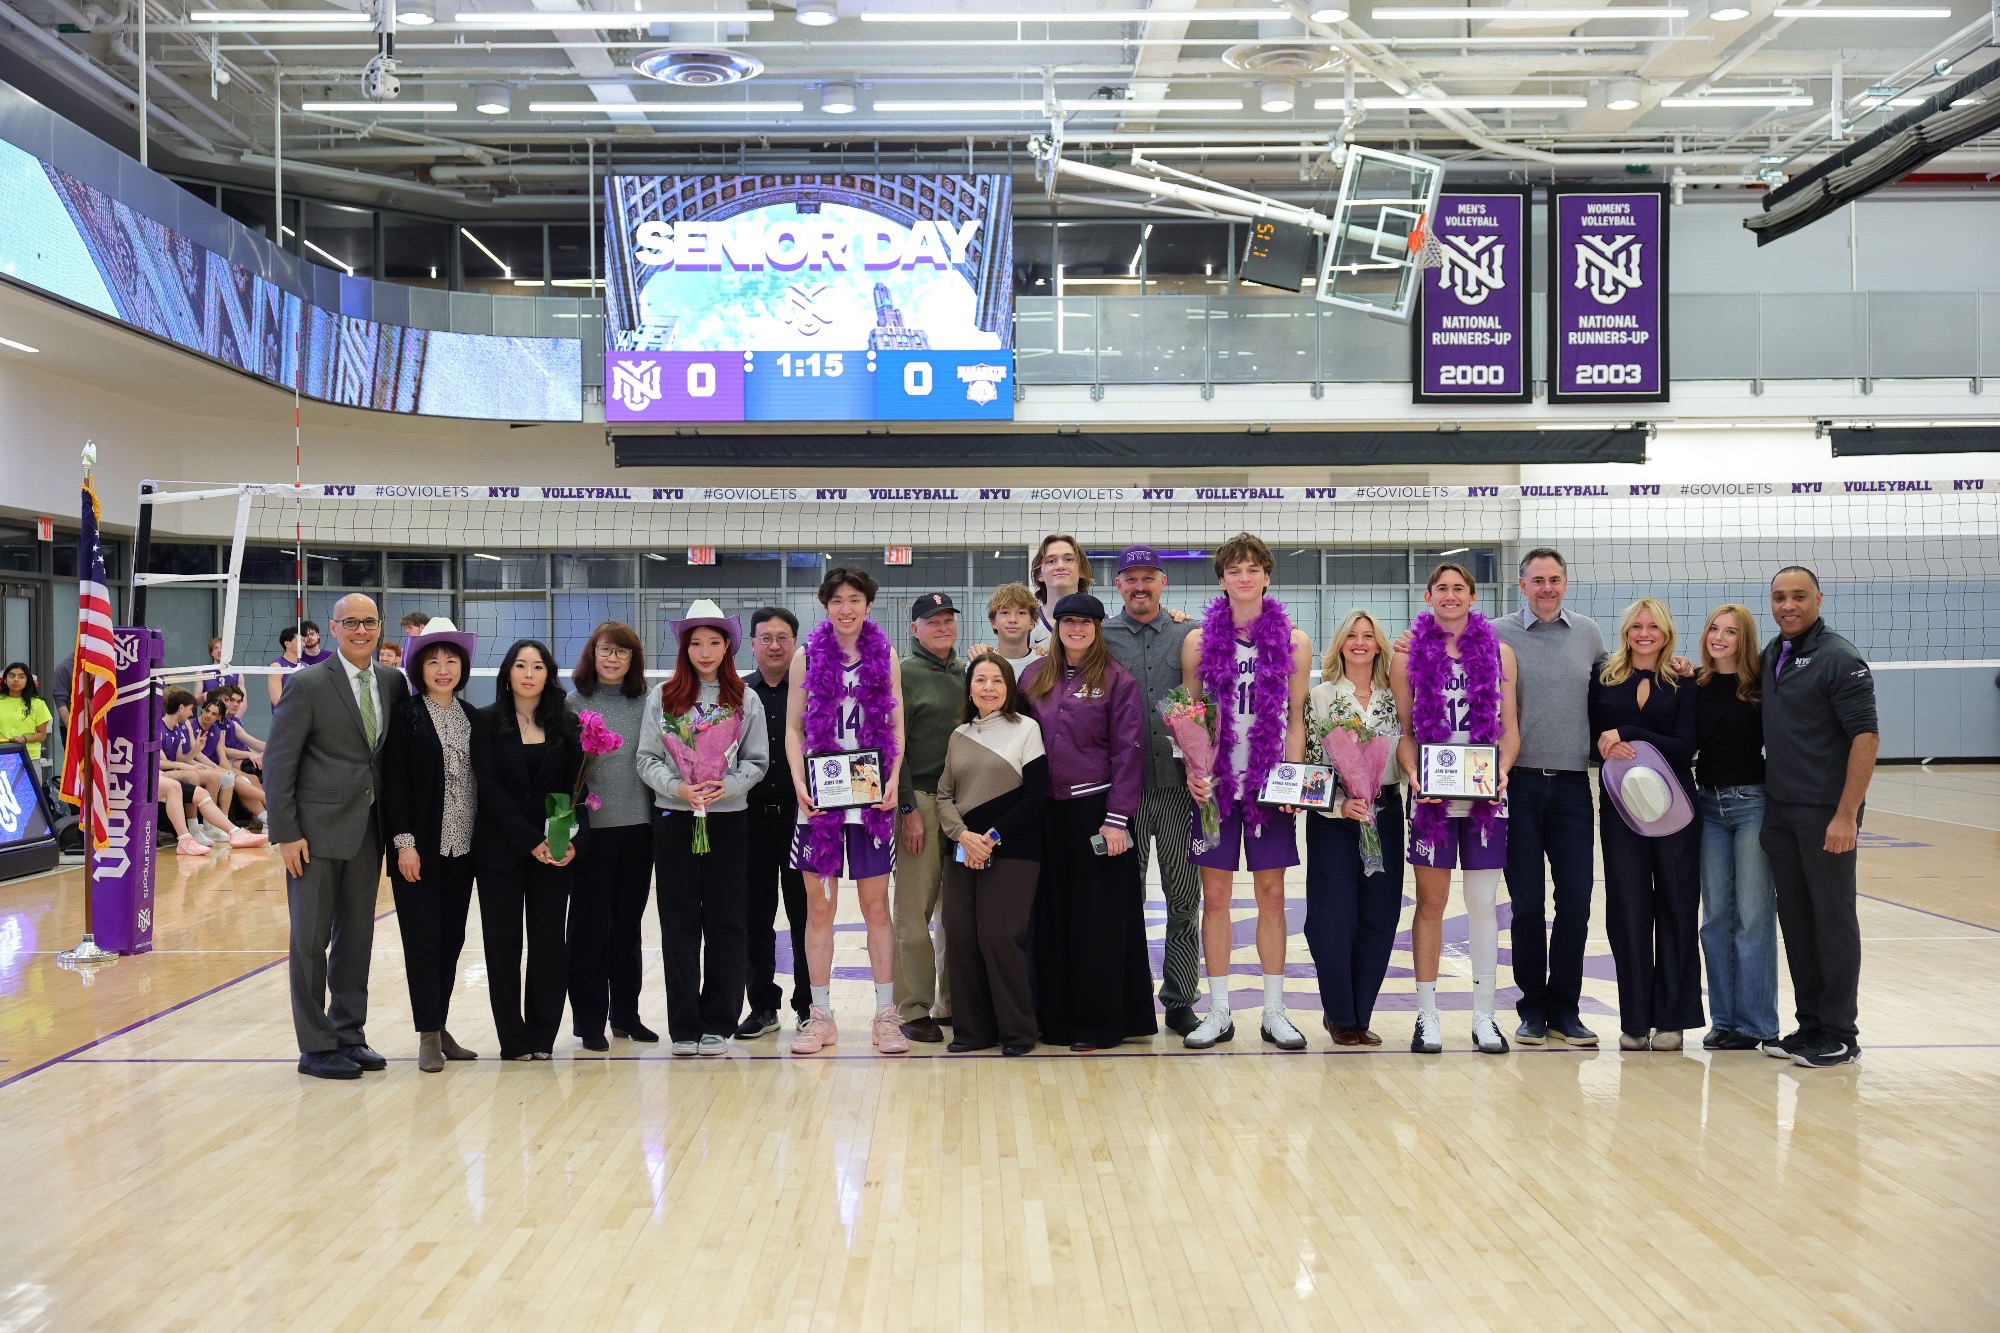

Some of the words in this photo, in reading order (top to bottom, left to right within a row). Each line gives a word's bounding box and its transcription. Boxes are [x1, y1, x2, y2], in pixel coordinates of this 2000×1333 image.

[1458, 204, 1486, 214] MEN'S
[1587, 204, 1630, 214] WOMEN'S
[1445, 216, 1499, 227] VOLLEYBALL
[1581, 216, 1636, 226] VOLLEYBALL
[635, 221, 848, 272] SENIOR
[862, 220, 981, 271] DAY
[1442, 316, 1501, 329] NATIONAL
[1579, 315, 1639, 328] NATIONAL
[1432, 332, 1512, 345] RUNNERS-UP
[1568, 331, 1649, 345] RUNNERS-UP
[776, 353, 843, 377] 1:15
[687, 363, 716, 397] 0
[904, 362, 933, 396] 0
[1440, 365, 1505, 385] 2000
[1576, 364, 1641, 384] 2003
[324, 485, 355, 496] NYU
[375, 485, 469, 498] #GOVIOLETS
[488, 486, 520, 498] NYU
[541, 487, 631, 499] VOLLEYBALL
[652, 488, 684, 500] NYU
[703, 488, 797, 500] #GOVIOLETS
[816, 489, 847, 500] NYU
[869, 489, 958, 500] VOLLEYBALL
[980, 488, 1011, 499] NYU
[1030, 488, 1124, 500] #GOVIOLETS
[1143, 488, 1174, 499] NYU
[1195, 488, 1284, 499] VOLLEYBALL
[1306, 487, 1336, 499] NYU
[1356, 486, 1449, 498] #GOVIOLETS
[1467, 486, 1498, 497] NYU
[1520, 485, 1608, 497] VOLLEYBALL
[1630, 484, 1660, 495] NYU
[1680, 483, 1772, 495] #GOVIOLETS
[1791, 482, 1822, 493] NYU
[1844, 481, 1932, 492] VOLLEYBALL
[1953, 480, 1984, 490] NYU
[691, 546, 712, 563] EXIT
[888, 546, 909, 563] EXIT
[1127, 551, 1151, 562] NYU
[837, 704, 861, 740] 14
[1447, 698, 1472, 731] 12
[142, 856, 150, 899] imports
